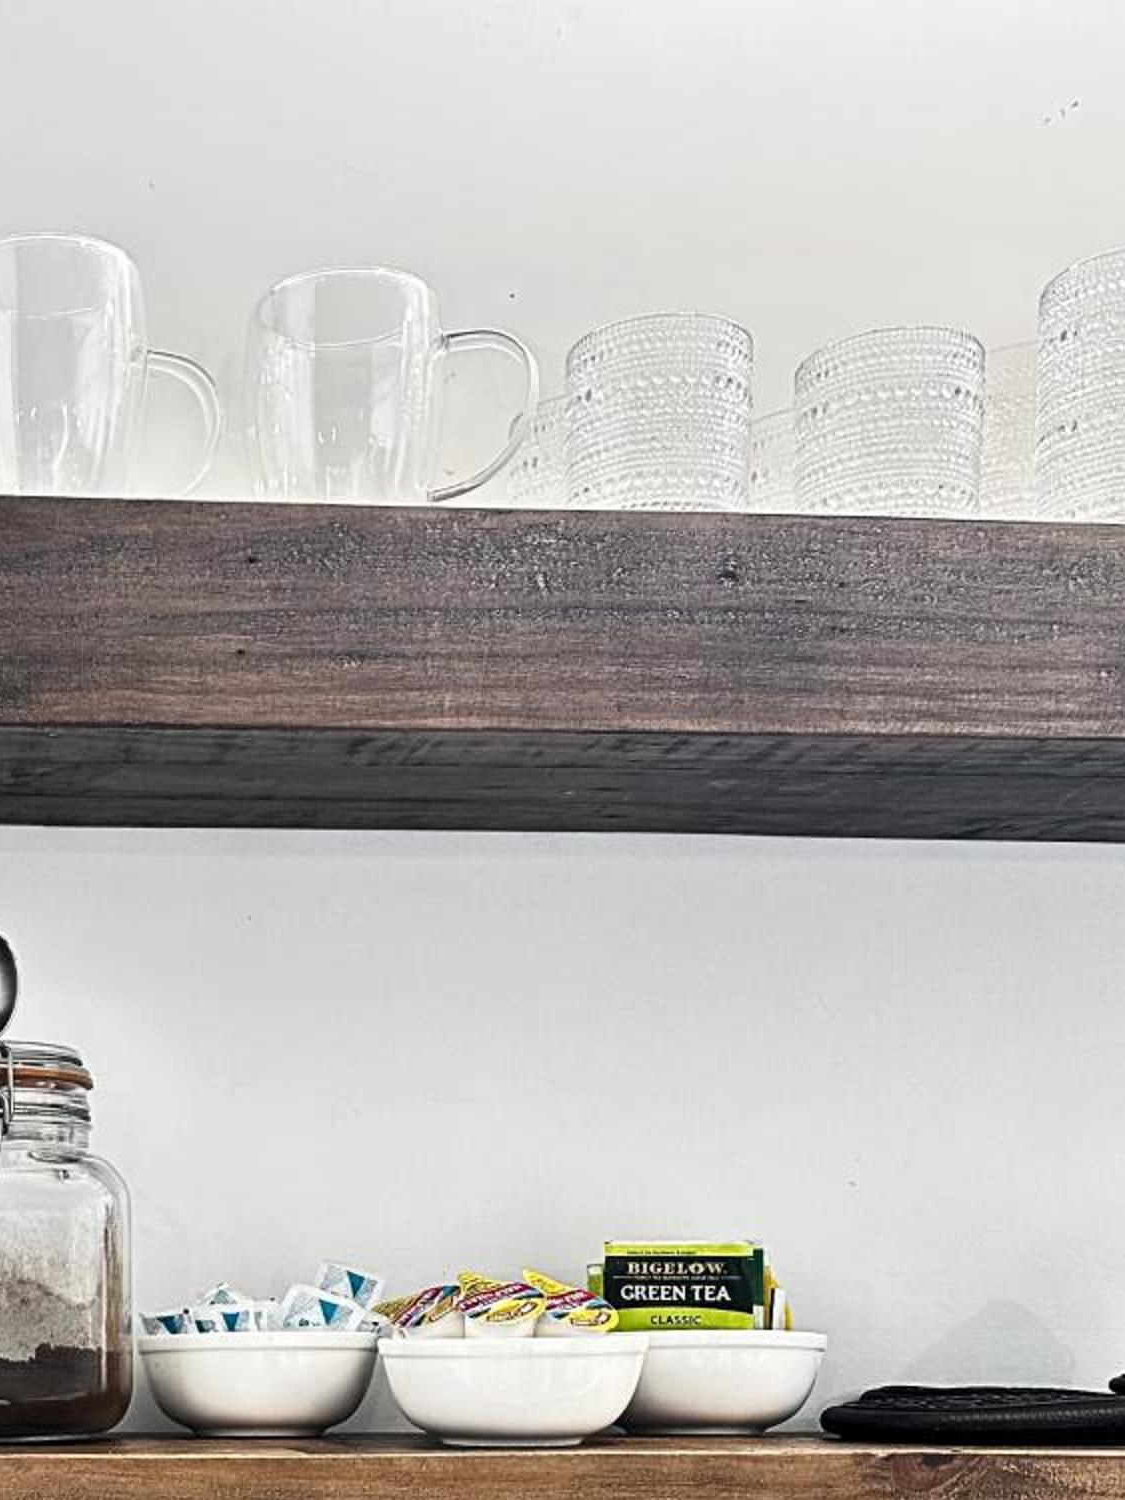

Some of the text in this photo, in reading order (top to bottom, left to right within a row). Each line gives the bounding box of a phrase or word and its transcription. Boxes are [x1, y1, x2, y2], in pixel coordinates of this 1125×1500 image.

[627, 1261, 723, 1275] BIGELOW
[620, 1284, 732, 1301] GREEN TEA
[650, 1314, 703, 1326] CLASSIC
